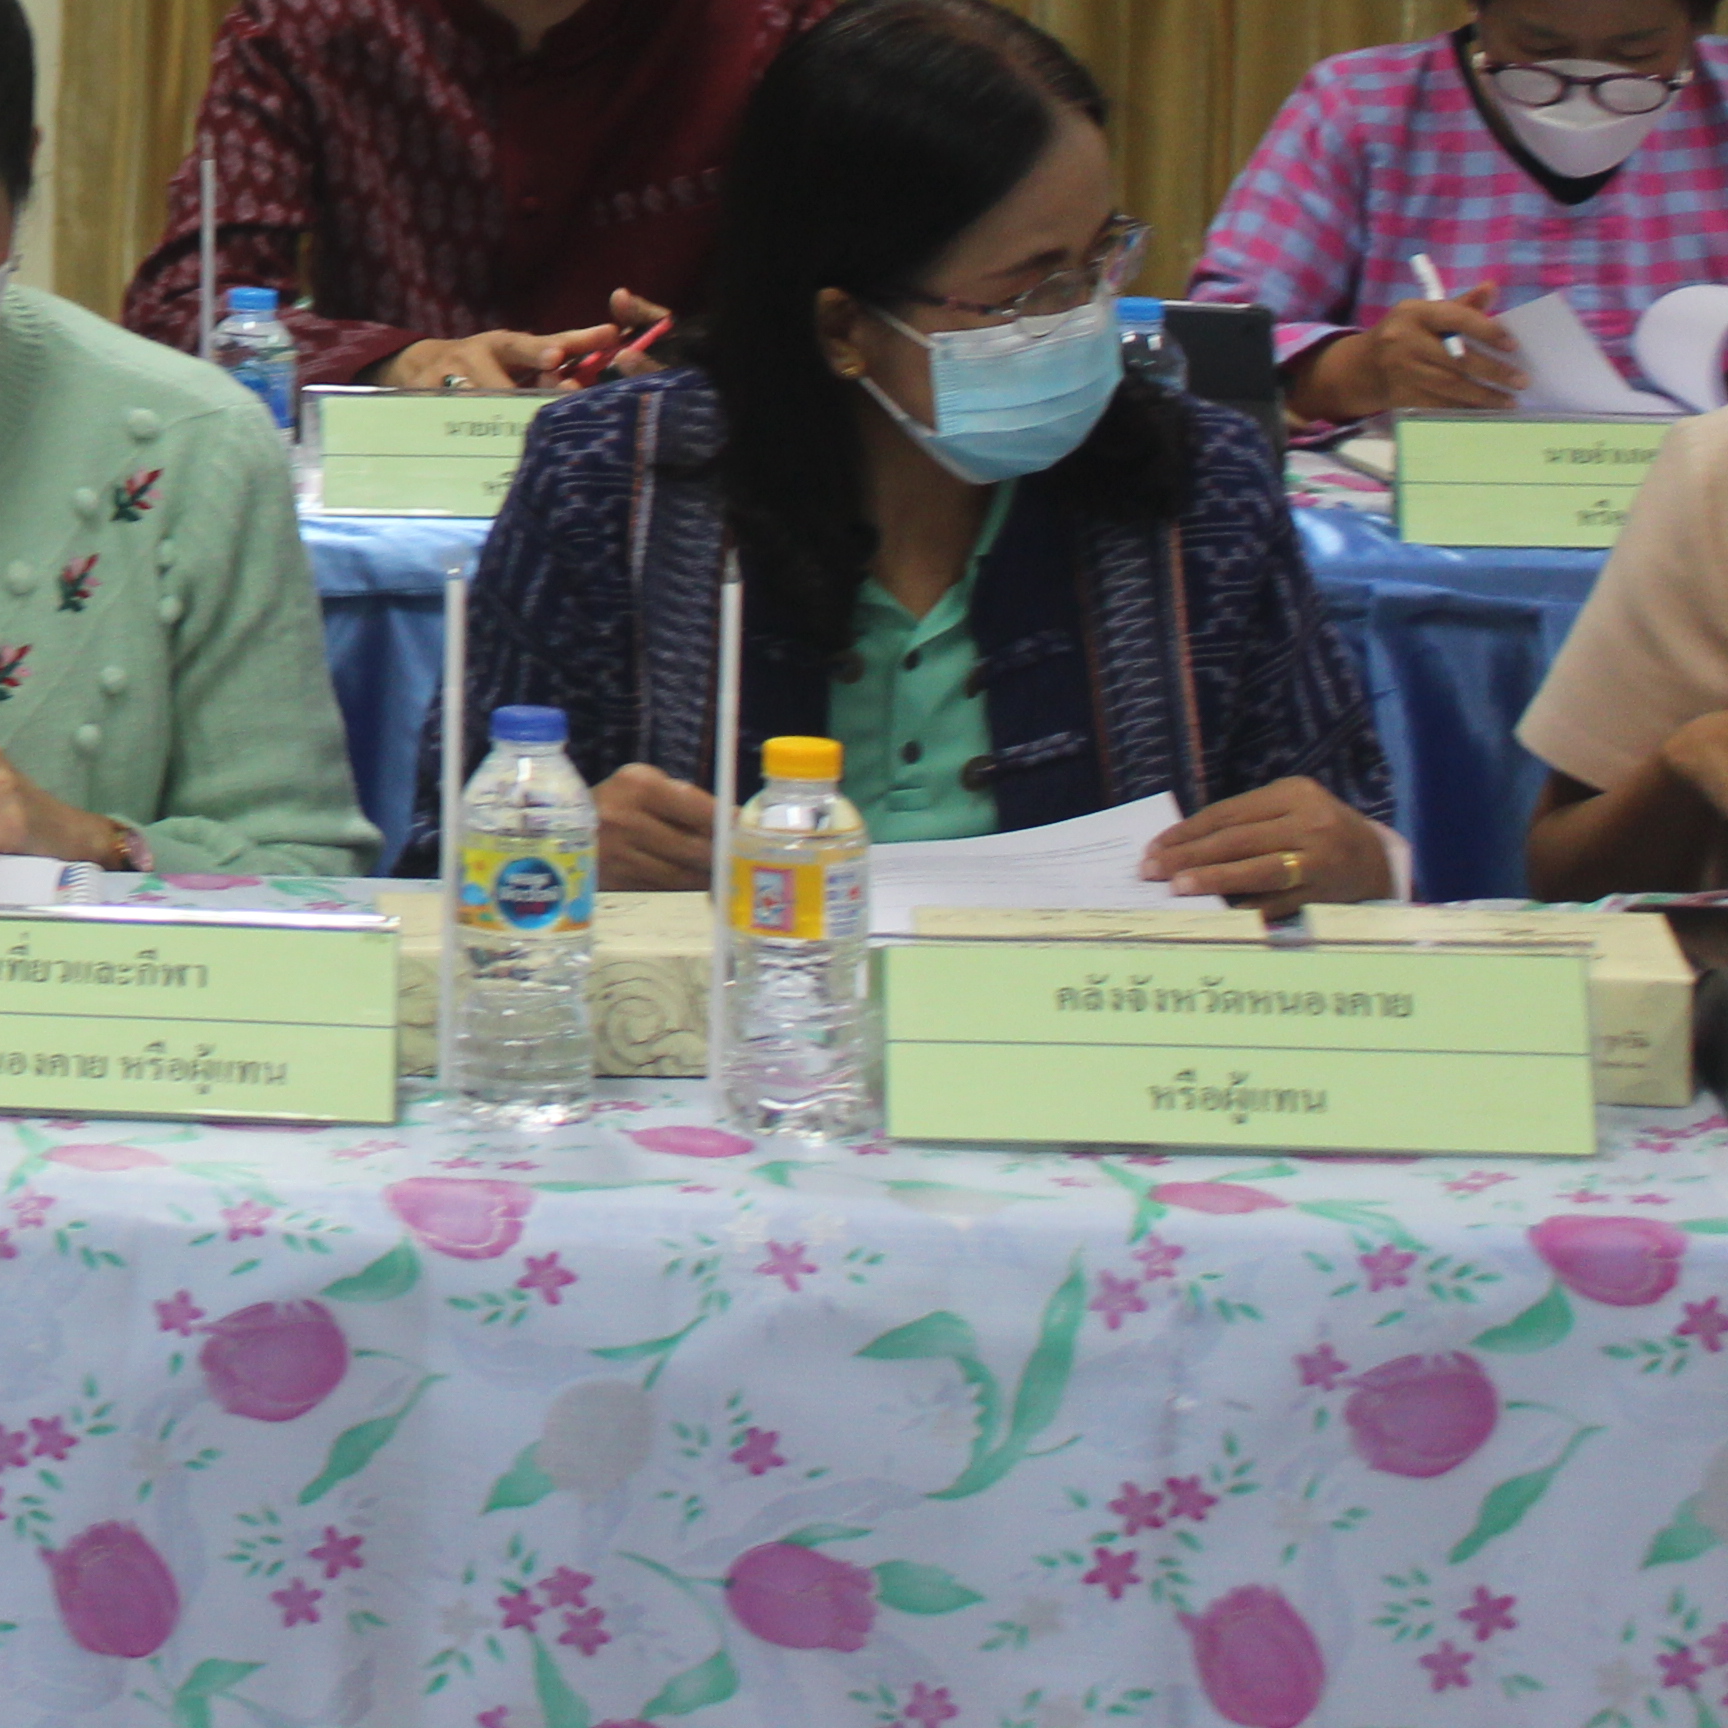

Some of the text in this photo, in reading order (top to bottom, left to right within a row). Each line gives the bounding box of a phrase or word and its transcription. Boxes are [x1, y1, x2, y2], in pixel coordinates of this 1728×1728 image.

[1055, 974, 1414, 1018] คลังจังหวัดหนองคาย
[117, 1040, 287, 1095] หรือผู้แทน
[1147, 1068, 1328, 1125] หรือผู้แทน
